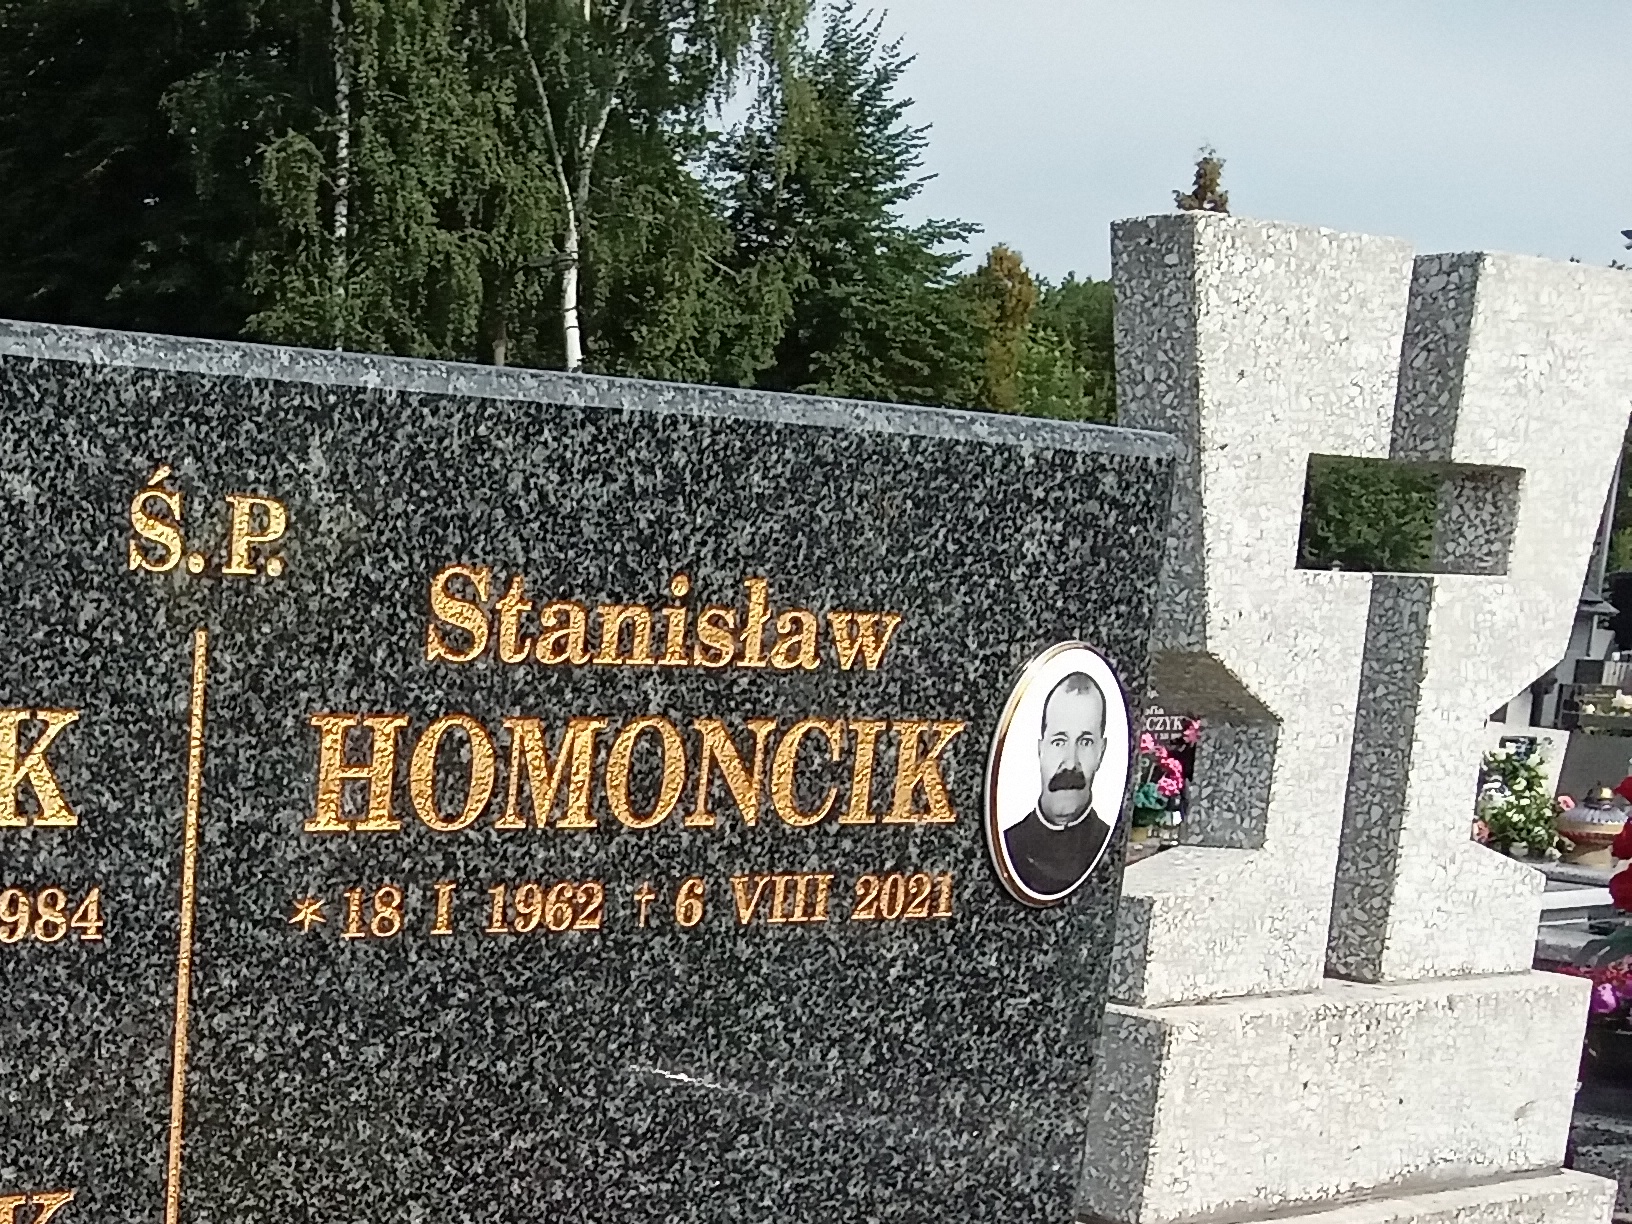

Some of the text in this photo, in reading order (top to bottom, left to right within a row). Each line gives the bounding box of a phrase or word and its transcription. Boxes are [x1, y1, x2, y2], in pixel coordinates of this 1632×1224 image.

[425, 564, 903, 672] Stanisław
[304, 713, 967, 833] HOMONCIK
[340, 870, 954, 940] 18 I 1962 6 VIII 2021
